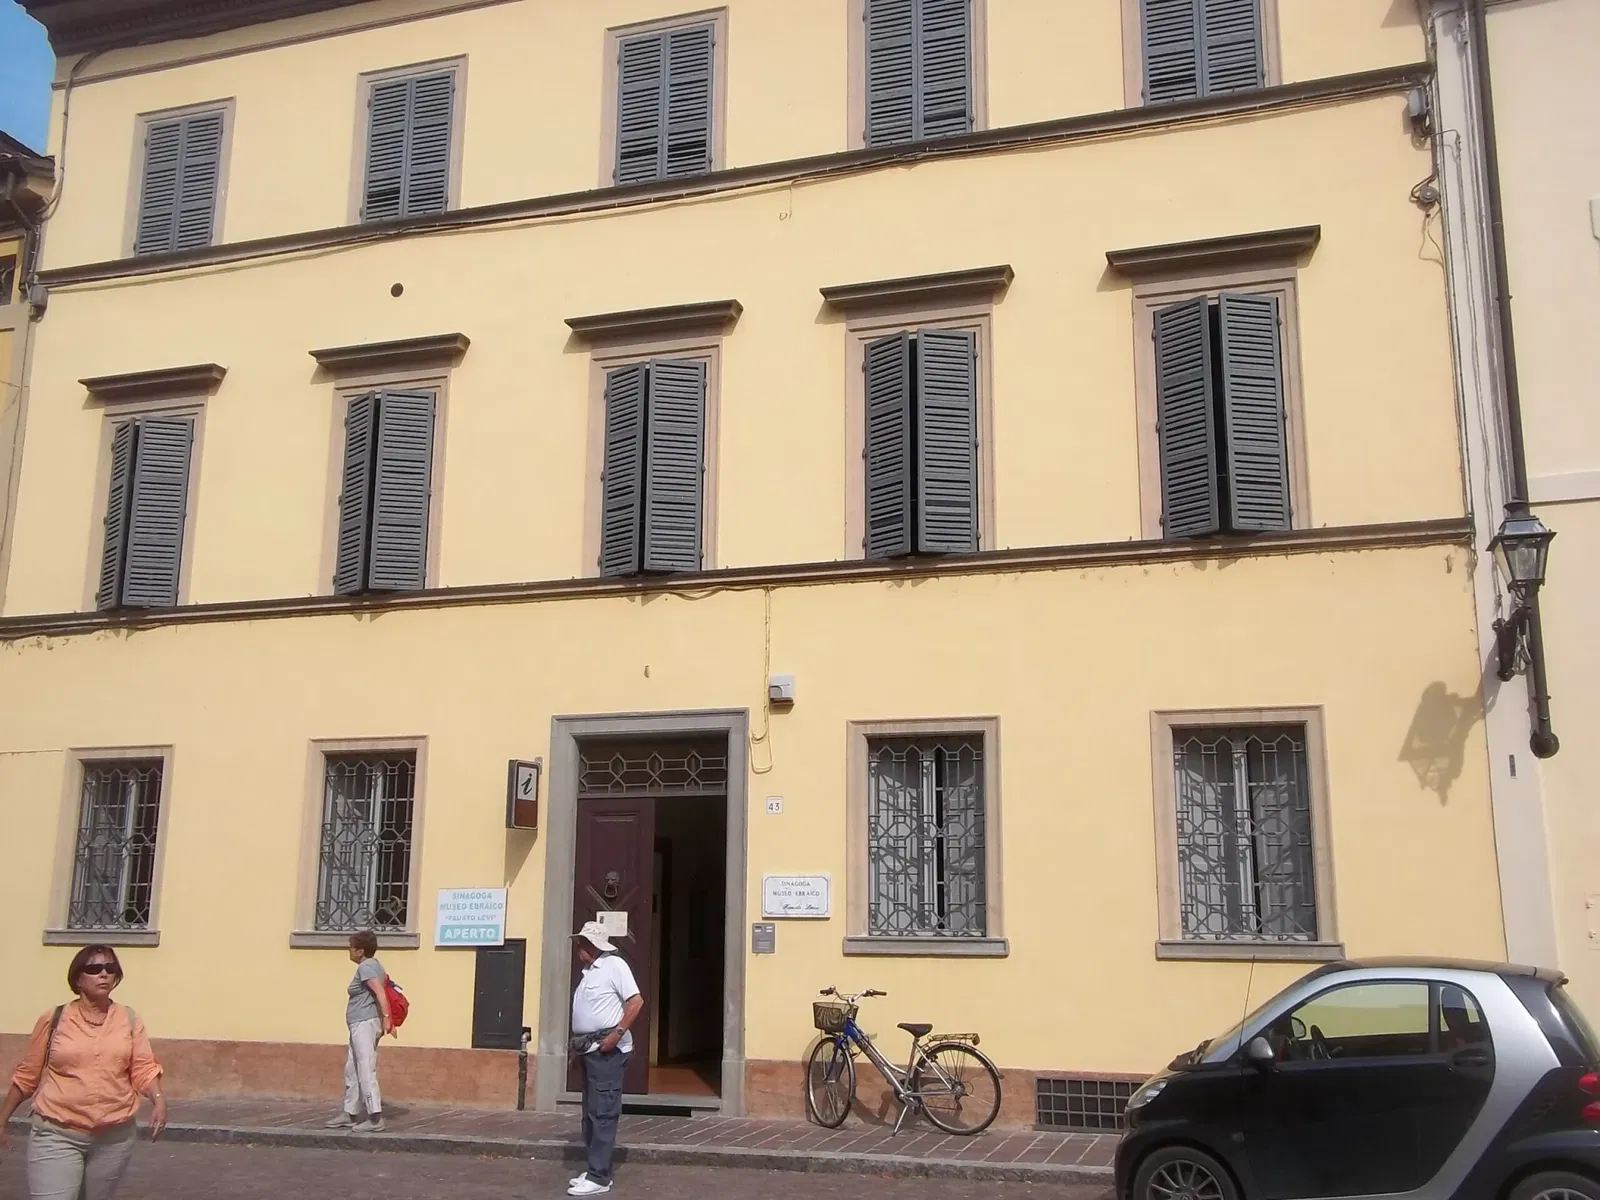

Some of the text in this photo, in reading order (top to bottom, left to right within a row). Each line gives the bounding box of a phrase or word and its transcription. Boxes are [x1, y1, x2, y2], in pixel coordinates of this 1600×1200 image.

[768, 802, 780, 811] 43
[452, 891, 493, 900] SINAGOGA
[440, 902, 504, 911] MUSEO EBRAICO
[444, 927, 496, 940] APERTO
